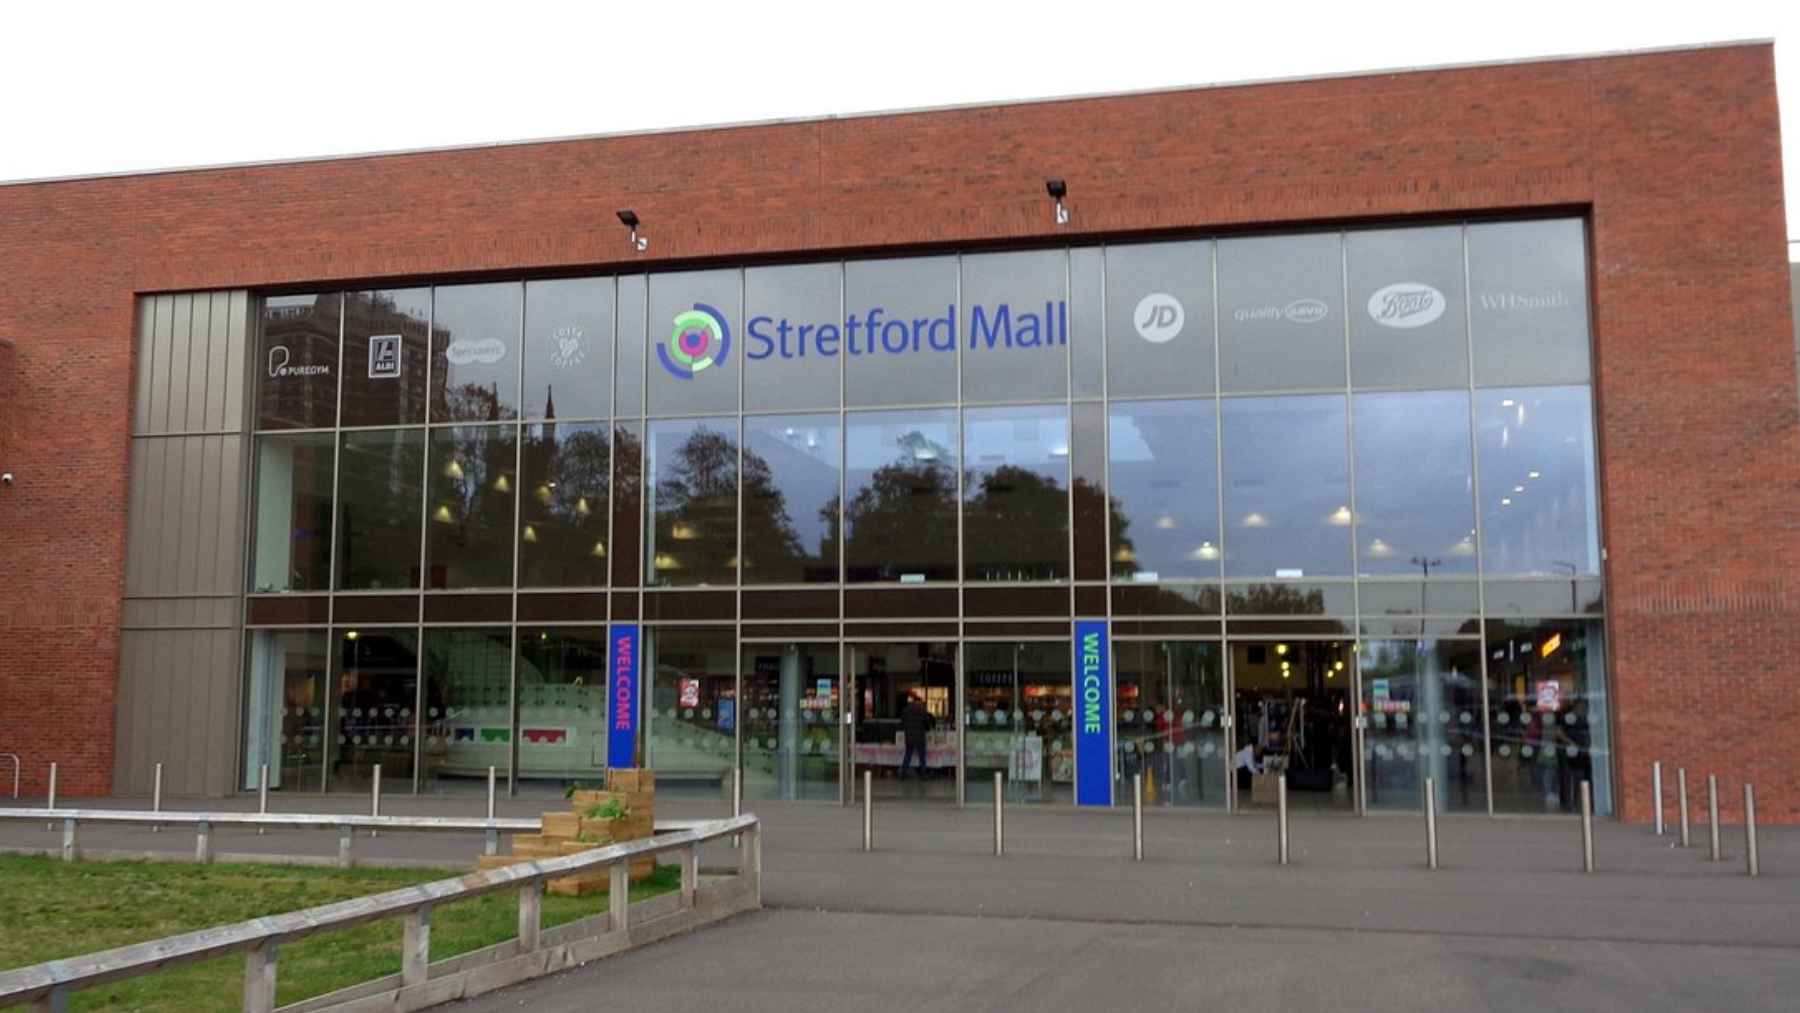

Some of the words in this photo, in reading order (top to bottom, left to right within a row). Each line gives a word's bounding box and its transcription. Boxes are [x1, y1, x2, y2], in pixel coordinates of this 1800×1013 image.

[1235, 304, 1285, 321] quality
[1375, 289, 1434, 323] Boots
[1480, 289, 1569, 312] WHSmith
[1142, 303, 1173, 329] JD
[747, 304, 956, 360] Stretford
[970, 301, 1066, 350] Mall
[287, 365, 330, 377] PUREGYM
[375, 361, 396, 372] ALDI
[615, 636, 632, 730] WELCOME
[1083, 632, 1101, 734] WELCOME
